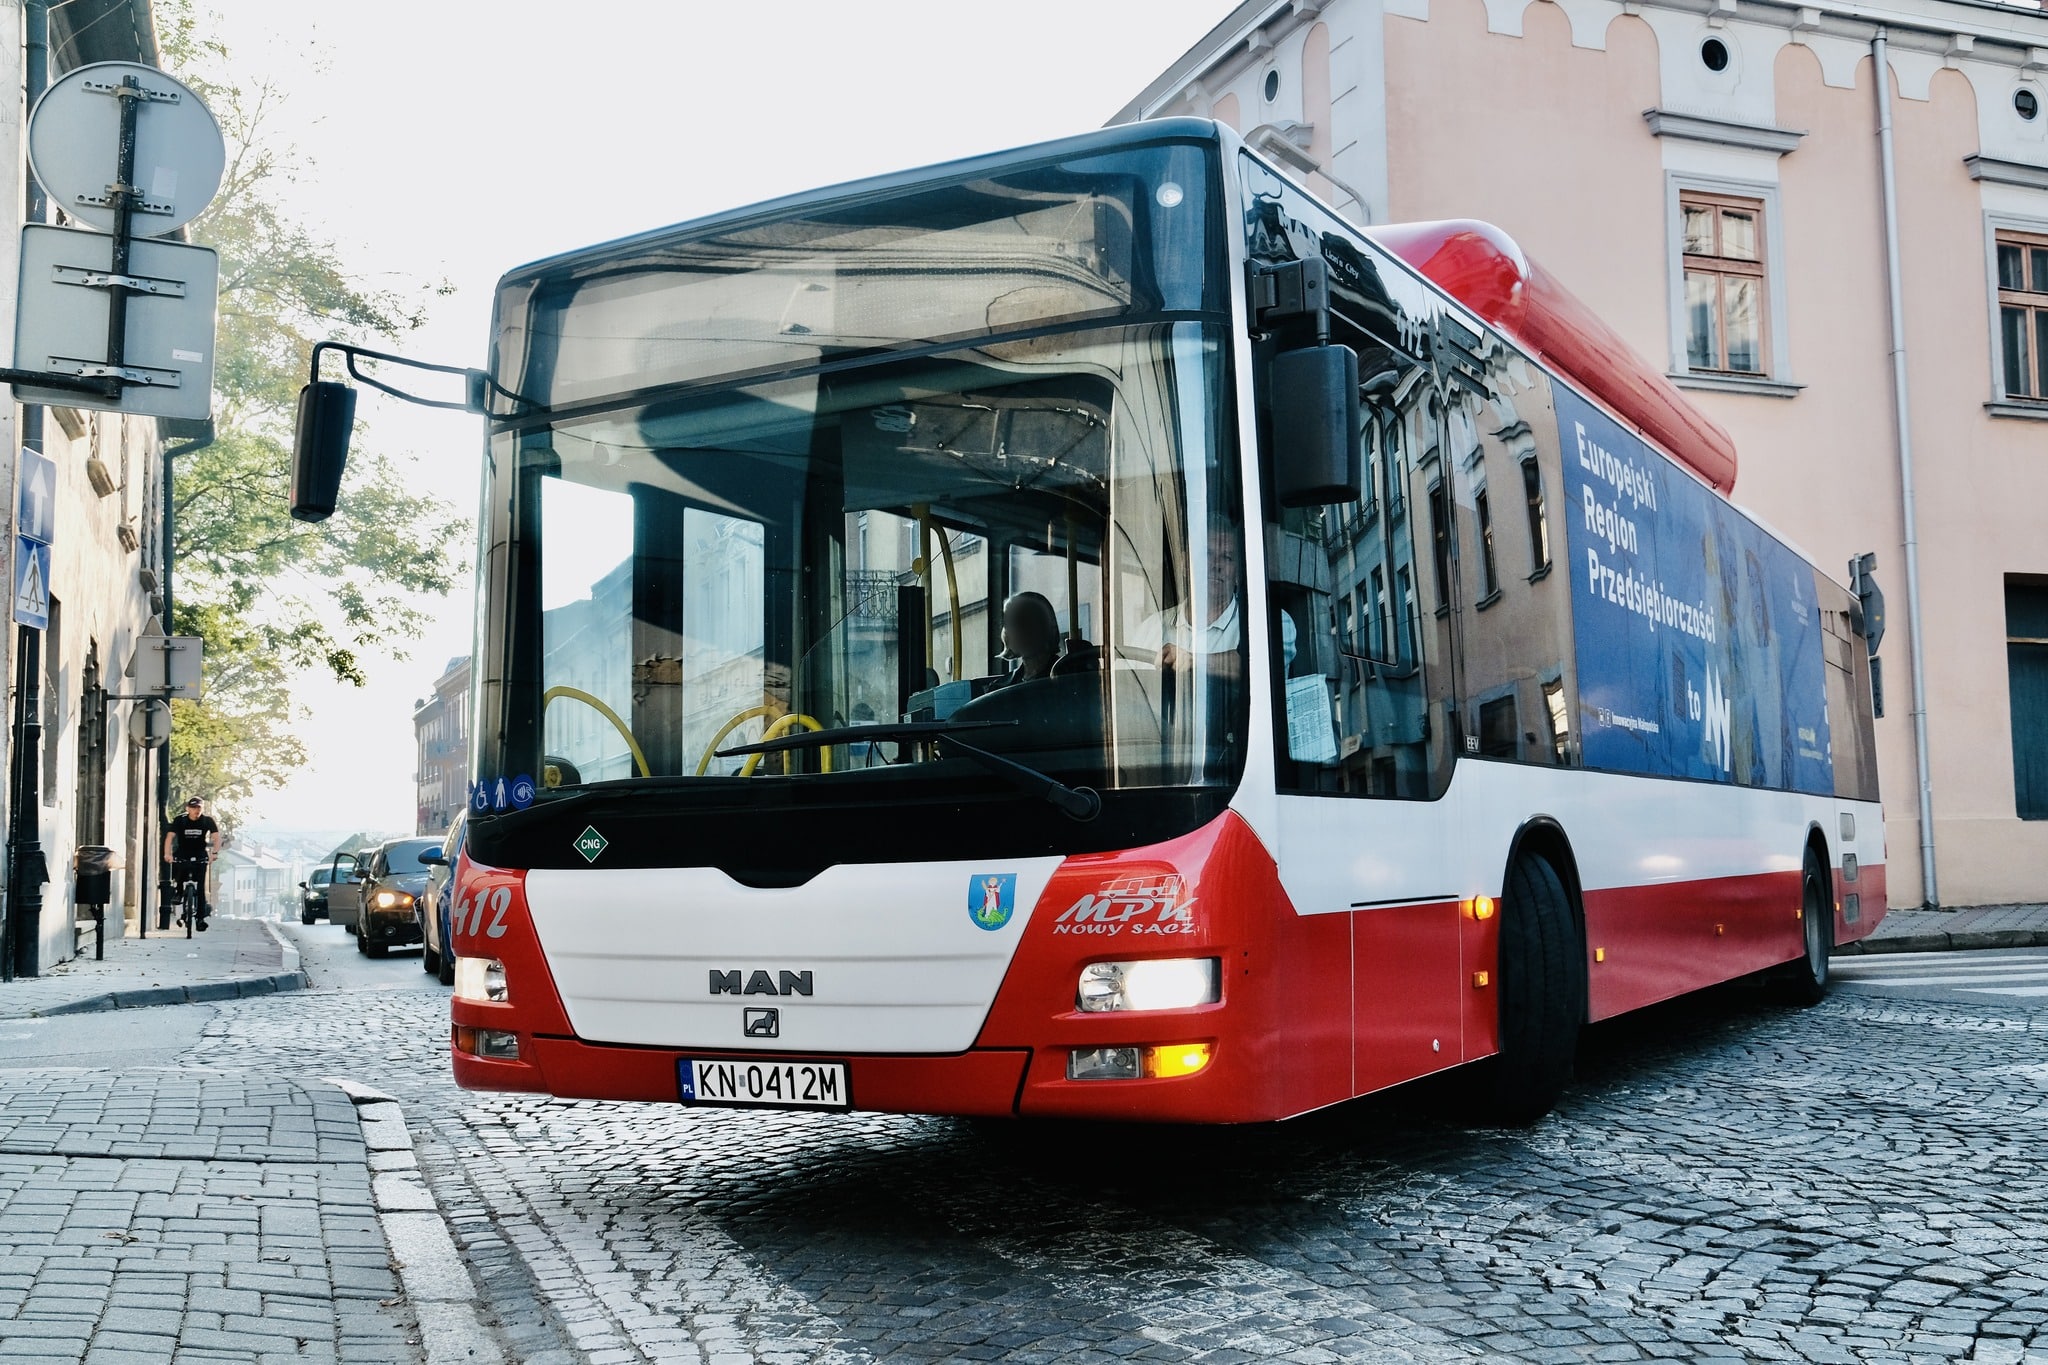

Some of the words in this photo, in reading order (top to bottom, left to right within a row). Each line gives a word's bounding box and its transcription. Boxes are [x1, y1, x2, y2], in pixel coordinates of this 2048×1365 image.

[1345, 262, 1359, 280] City
[1574, 420, 1657, 512] Europejski
[1582, 483, 1638, 555] Region
[1587, 547, 1717, 644] Przedsiębiorczości
[1688, 680, 1701, 722] to
[581, 838, 601, 850] CNG
[453, 885, 512, 939] 412
[1054, 893, 1199, 923] MPK
[1052, 923, 1125, 937] NOWY
[708, 969, 814, 996] MAN
[683, 1083, 694, 1094] PL
[698, 1063, 737, 1098] KN
[746, 1065, 838, 1101] 0412M
